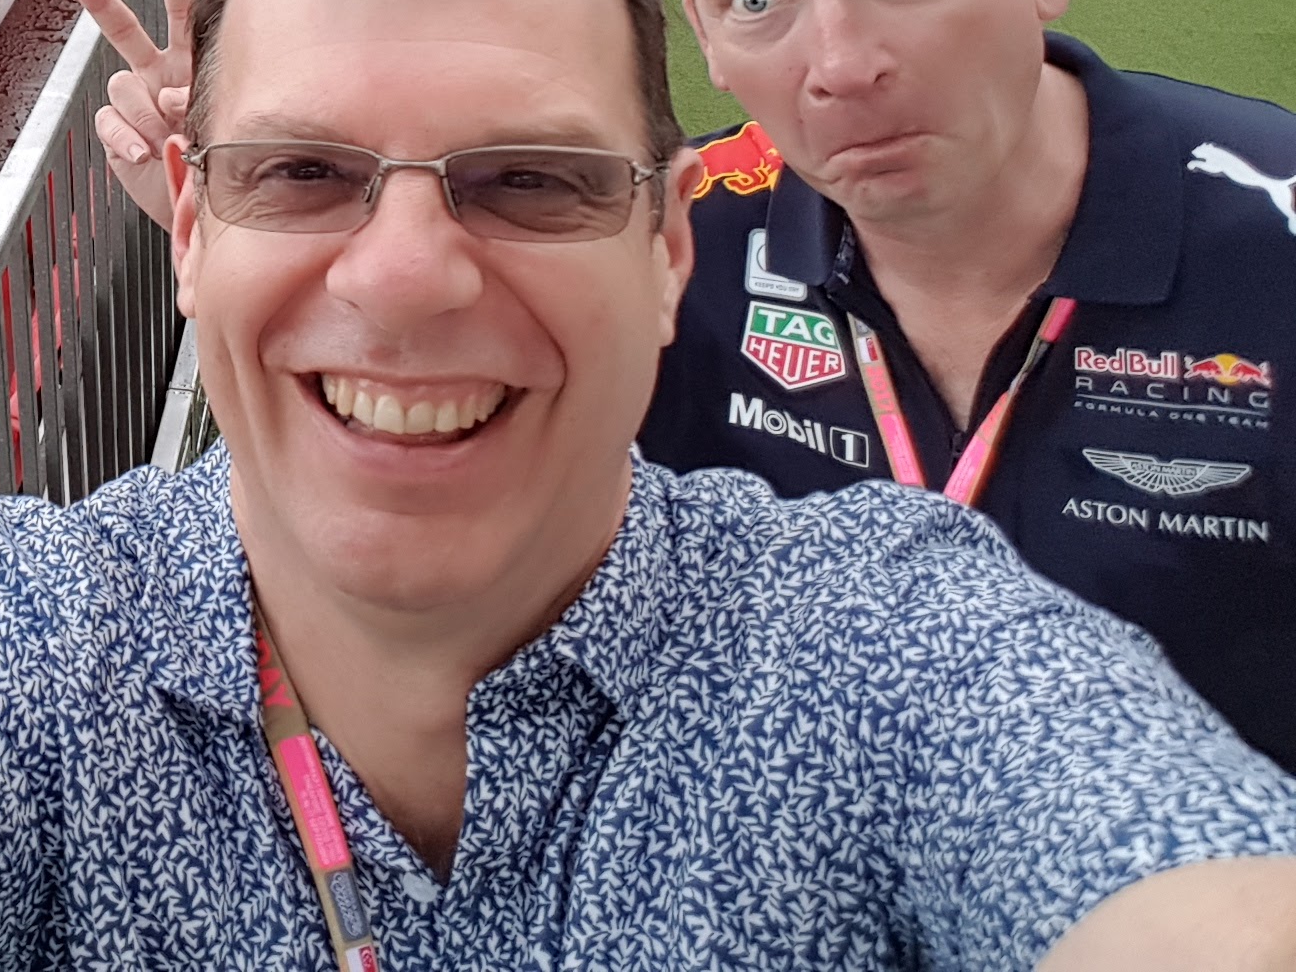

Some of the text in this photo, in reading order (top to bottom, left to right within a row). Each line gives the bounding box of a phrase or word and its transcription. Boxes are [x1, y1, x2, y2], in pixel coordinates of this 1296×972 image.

[757, 308, 836, 346] TAG
[748, 337, 839, 383] HEUER
[1075, 376, 1270, 409] RACING
[728, 392, 826, 454] Mobil
[840, 433, 855, 462] 1
[1074, 400, 1270, 429] FORMULA ONE TEAM
[1062, 497, 1270, 543] ASTON MARTIN
